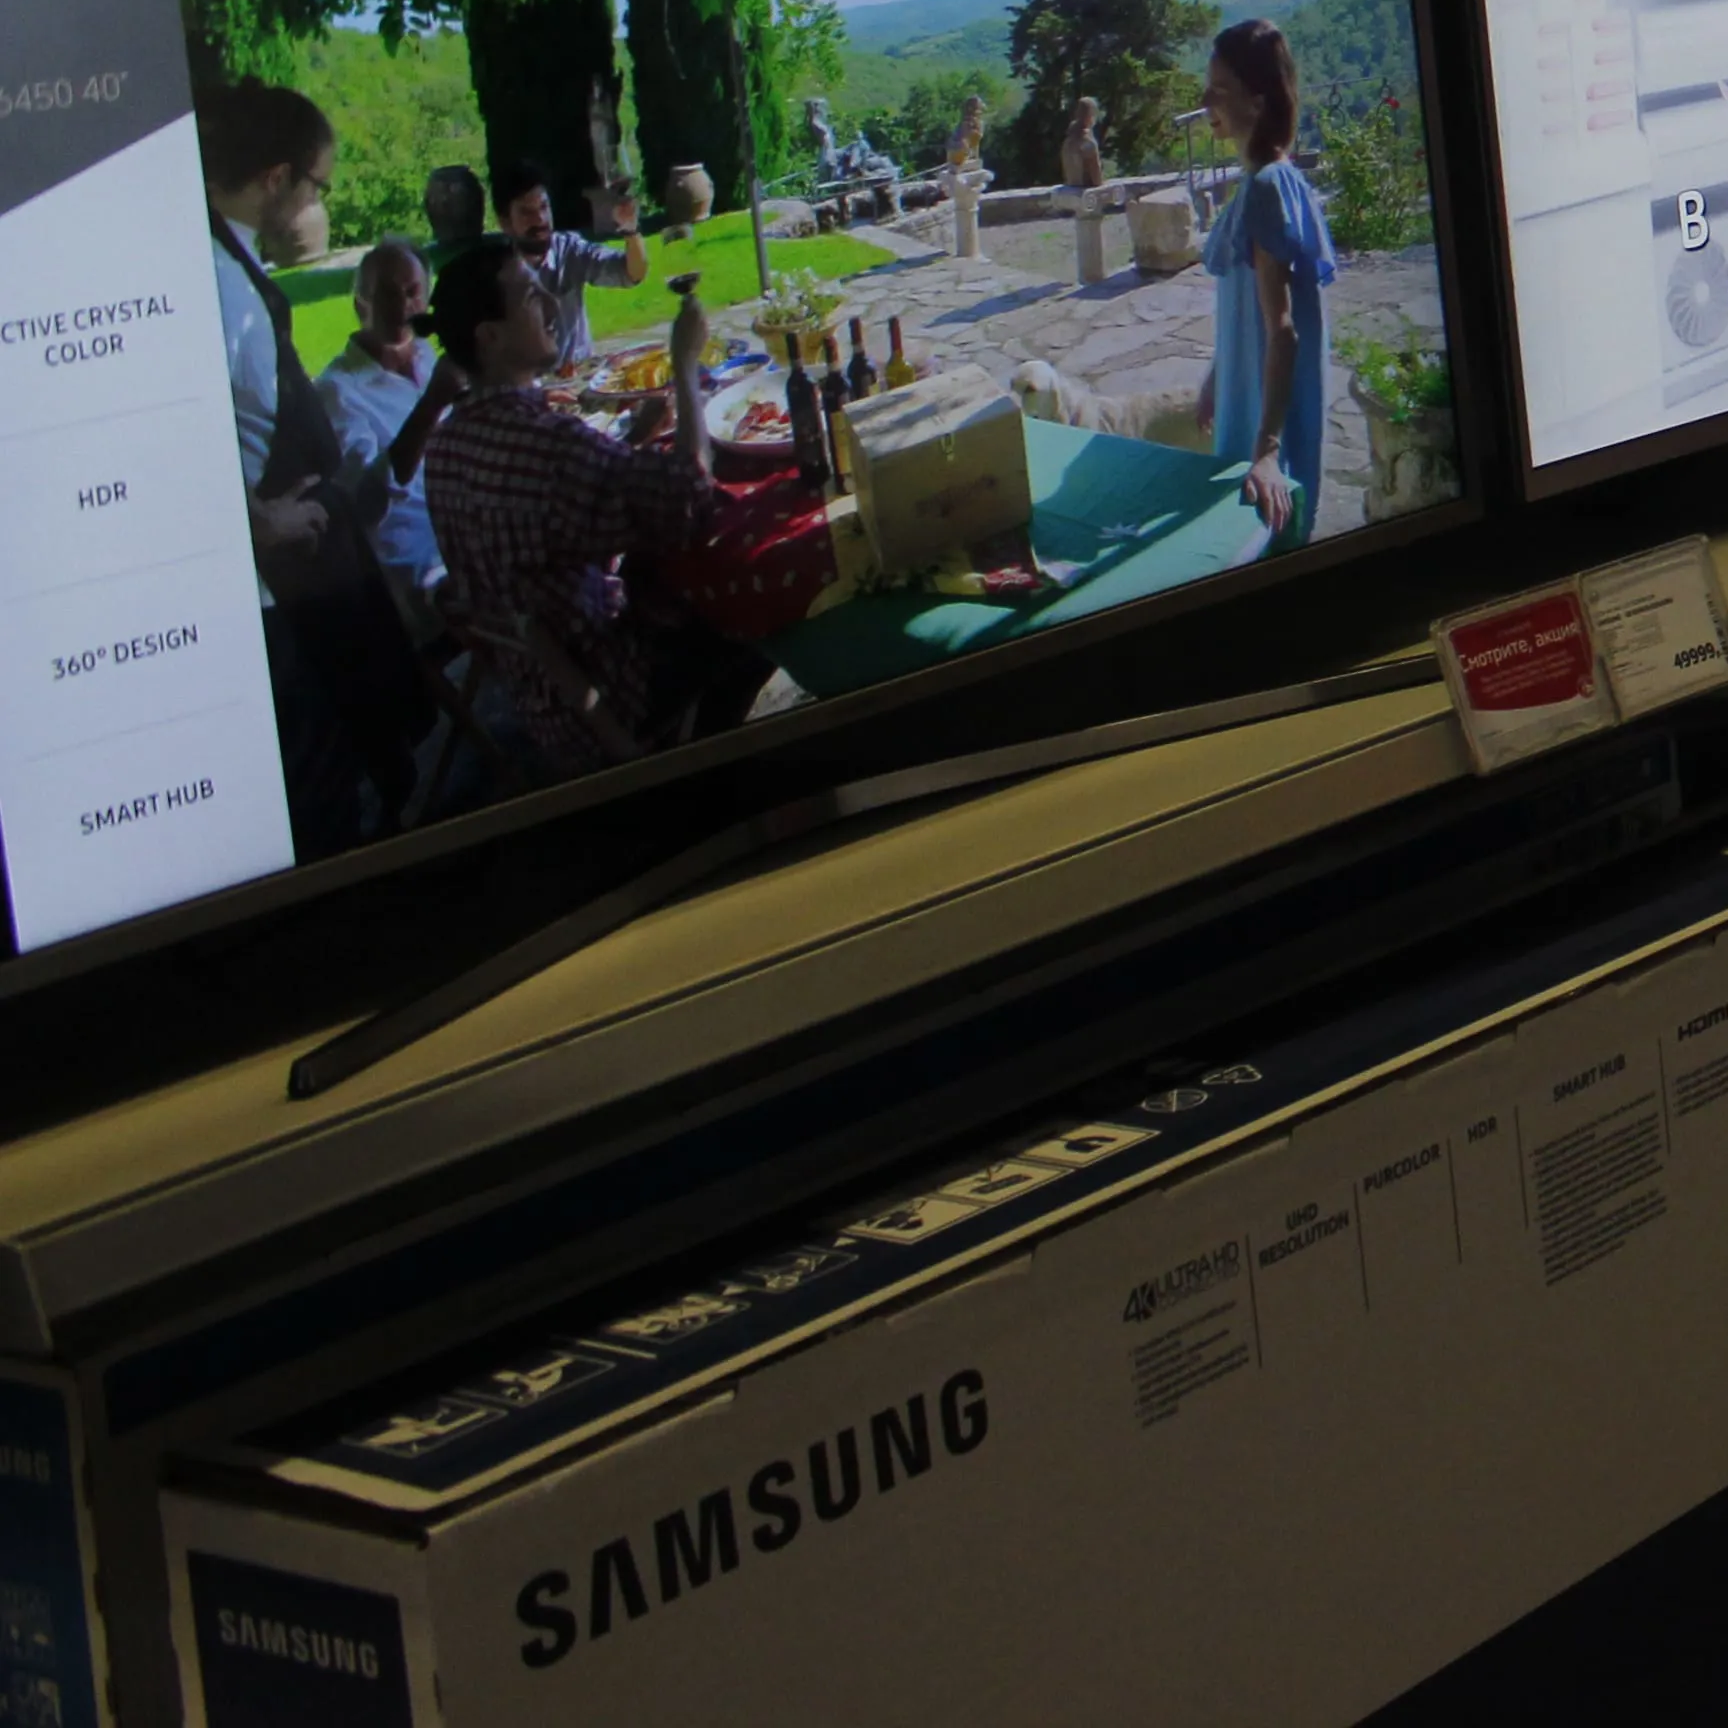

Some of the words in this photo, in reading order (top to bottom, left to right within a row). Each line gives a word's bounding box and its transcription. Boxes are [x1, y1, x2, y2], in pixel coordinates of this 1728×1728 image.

[1676, 188, 1709, 251] В
[73, 293, 175, 332] CRYSTAL
[44, 332, 126, 368] COLOR
[77, 480, 129, 510] HDR
[51, 646, 107, 681] 360°
[113, 623, 199, 666] DESIGN
[80, 792, 160, 837] SMART
[166, 776, 216, 812] HUB
[1552, 1067, 1598, 1103] SMART
[1600, 1053, 1627, 1080] HUB
[1467, 1115, 1498, 1145] HDR
[1363, 1141, 1442, 1194] PURCOLOR
[1258, 1209, 1350, 1268] RESOLUTION
[1285, 1202, 1319, 1231] UHD
[1123, 1284, 1157, 1323] 4K
[1212, 1239, 1240, 1270] HD
[516, 1368, 991, 1669] SAMSUNG
[216, 1607, 381, 1680] SAMSUNG
